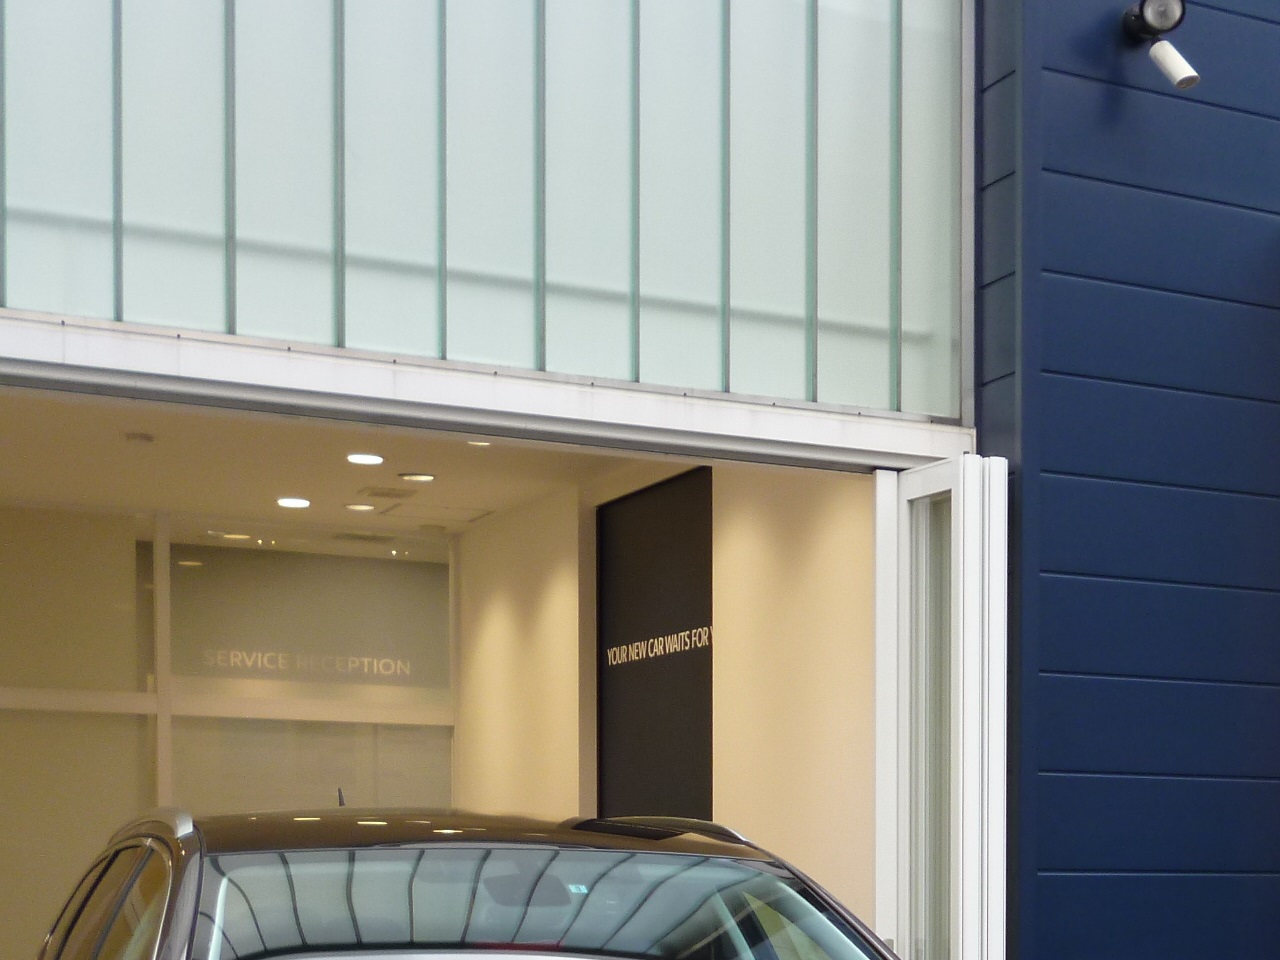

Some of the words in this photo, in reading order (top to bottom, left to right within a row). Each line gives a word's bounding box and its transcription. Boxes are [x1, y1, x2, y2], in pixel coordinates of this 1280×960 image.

[202, 650, 288, 669] SERVICE
[607, 645, 627, 666] YOUR
[628, 640, 647, 662] NEW
[648, 638, 664, 658] CAR
[665, 631, 690, 654] WAITS
[691, 627, 709, 648] FOR
